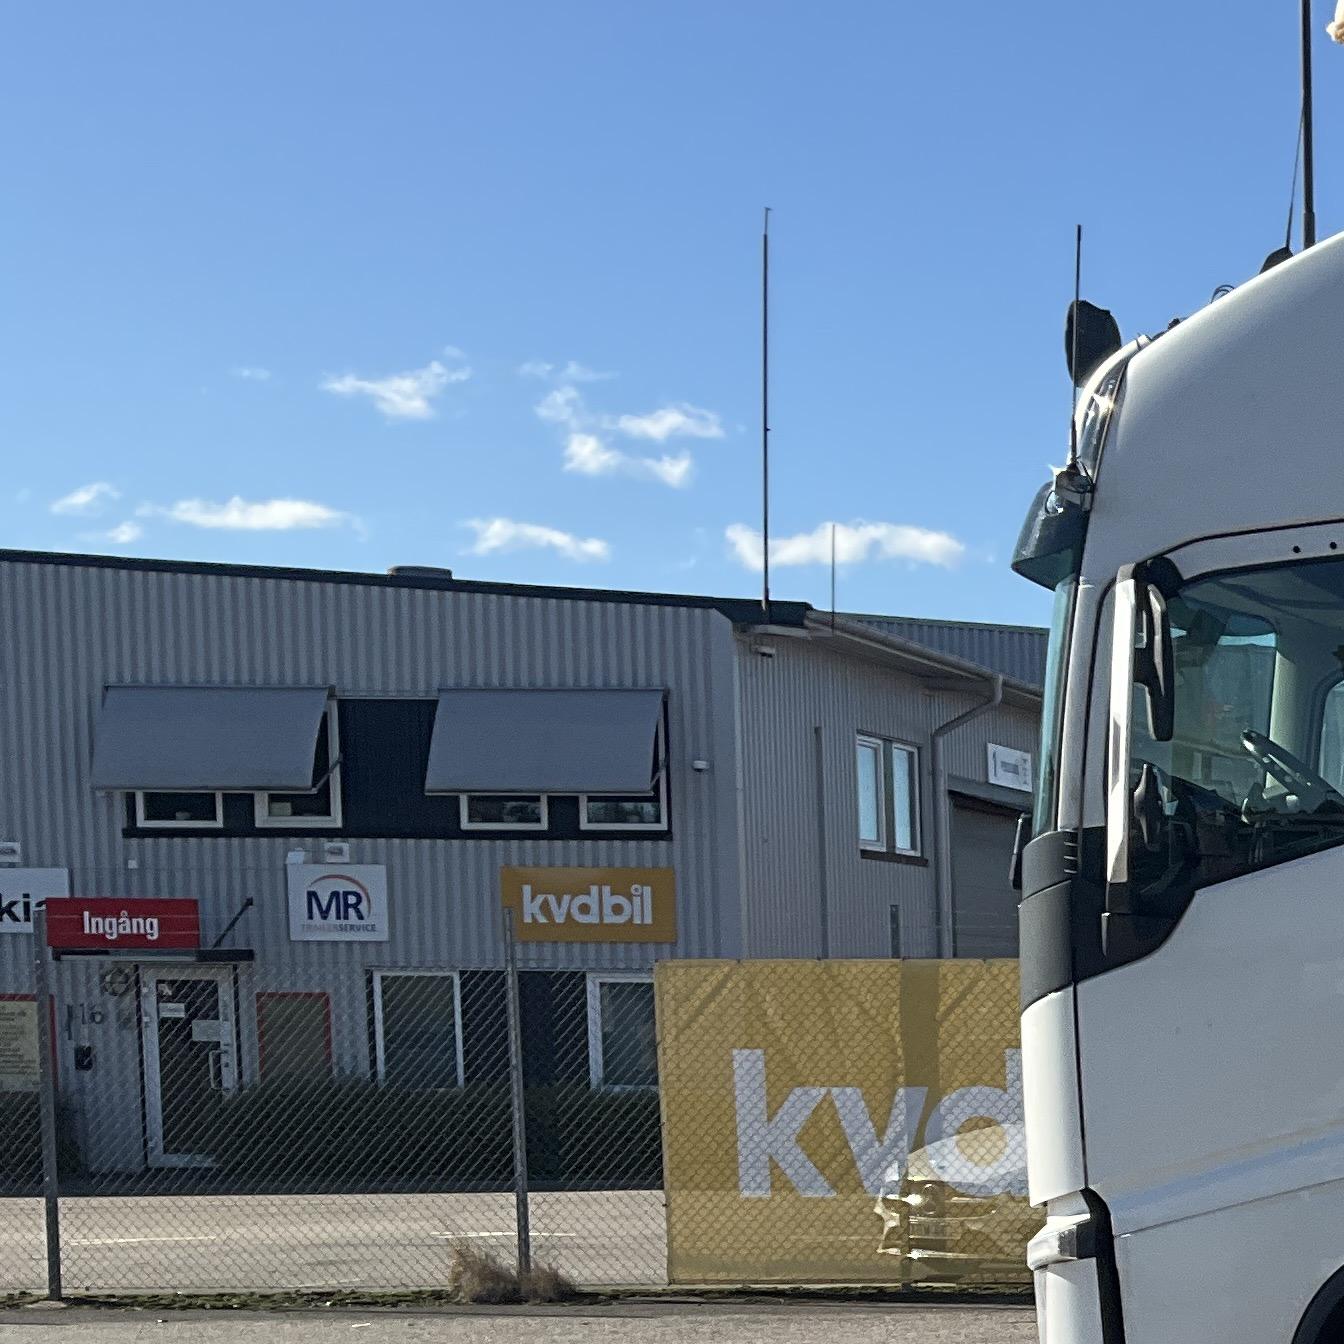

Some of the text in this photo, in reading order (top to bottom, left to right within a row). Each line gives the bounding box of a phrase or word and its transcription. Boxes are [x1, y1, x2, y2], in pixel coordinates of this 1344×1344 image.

[0, 893, 46, 922] ki
[306, 890, 364, 920] MR
[522, 884, 653, 924] kvdbil
[83, 910, 159, 940] Ingång
